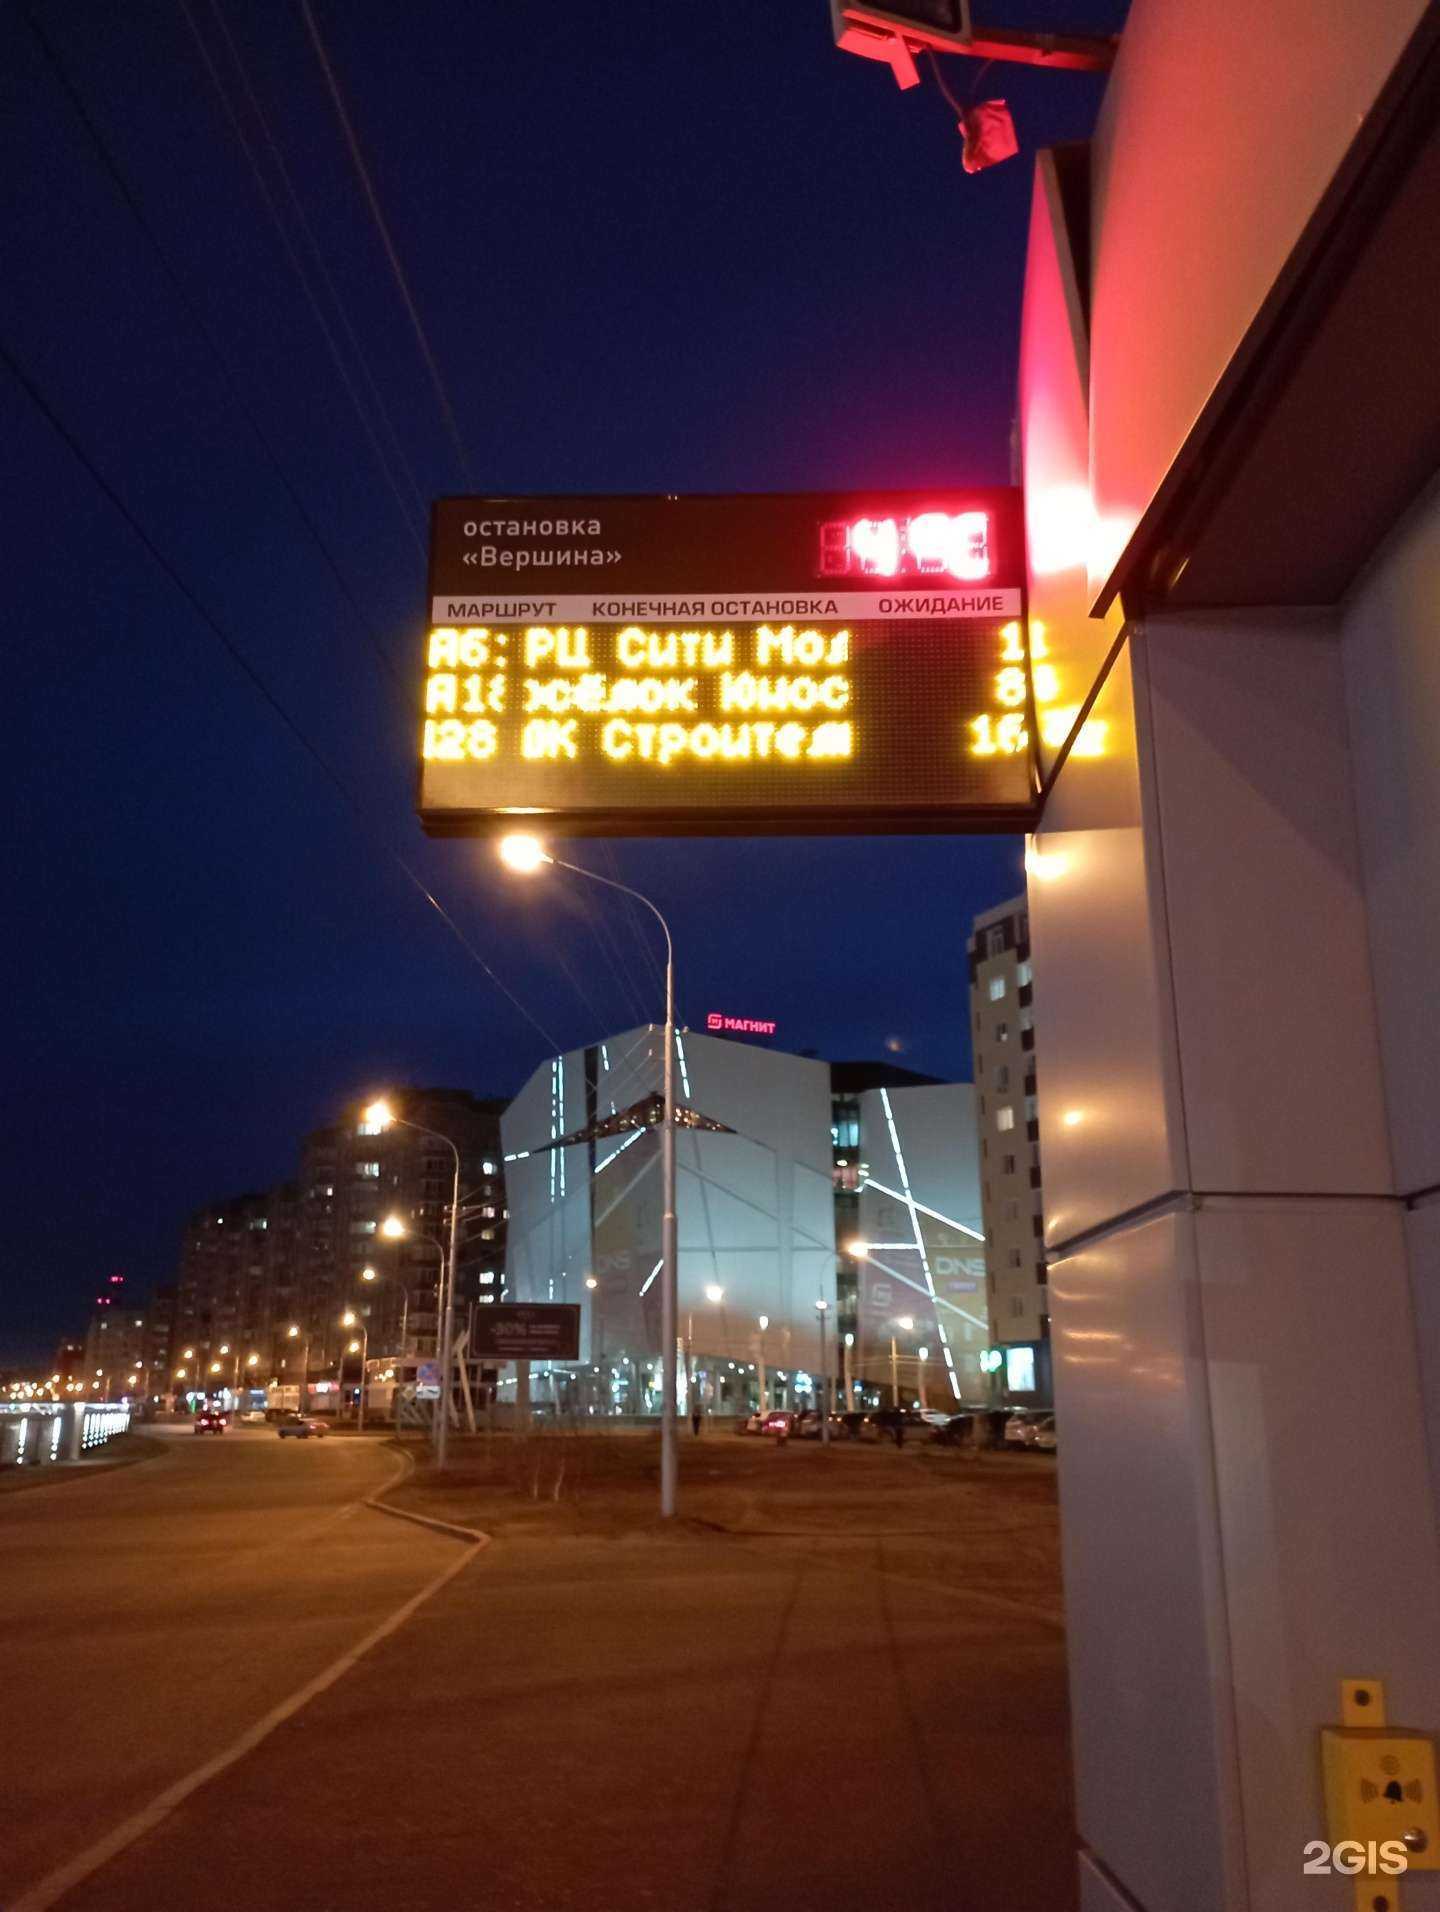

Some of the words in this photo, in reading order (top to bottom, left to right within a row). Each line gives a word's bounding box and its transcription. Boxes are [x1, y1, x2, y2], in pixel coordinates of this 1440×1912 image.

[463, 518, 601, 537] остановка
[462, 545, 623, 572] «Вершина»
[447, 601, 558, 619] МАРШРУТ
[592, 601, 706, 617] КОНЕЧНАЯ
[711, 599, 839, 616] ОСТАНОВКА
[878, 596, 1004, 615] ОЖИДАНИЕ
[616, 626, 734, 668] Сити
[724, 1017, 776, 1034] МАГНИТ
